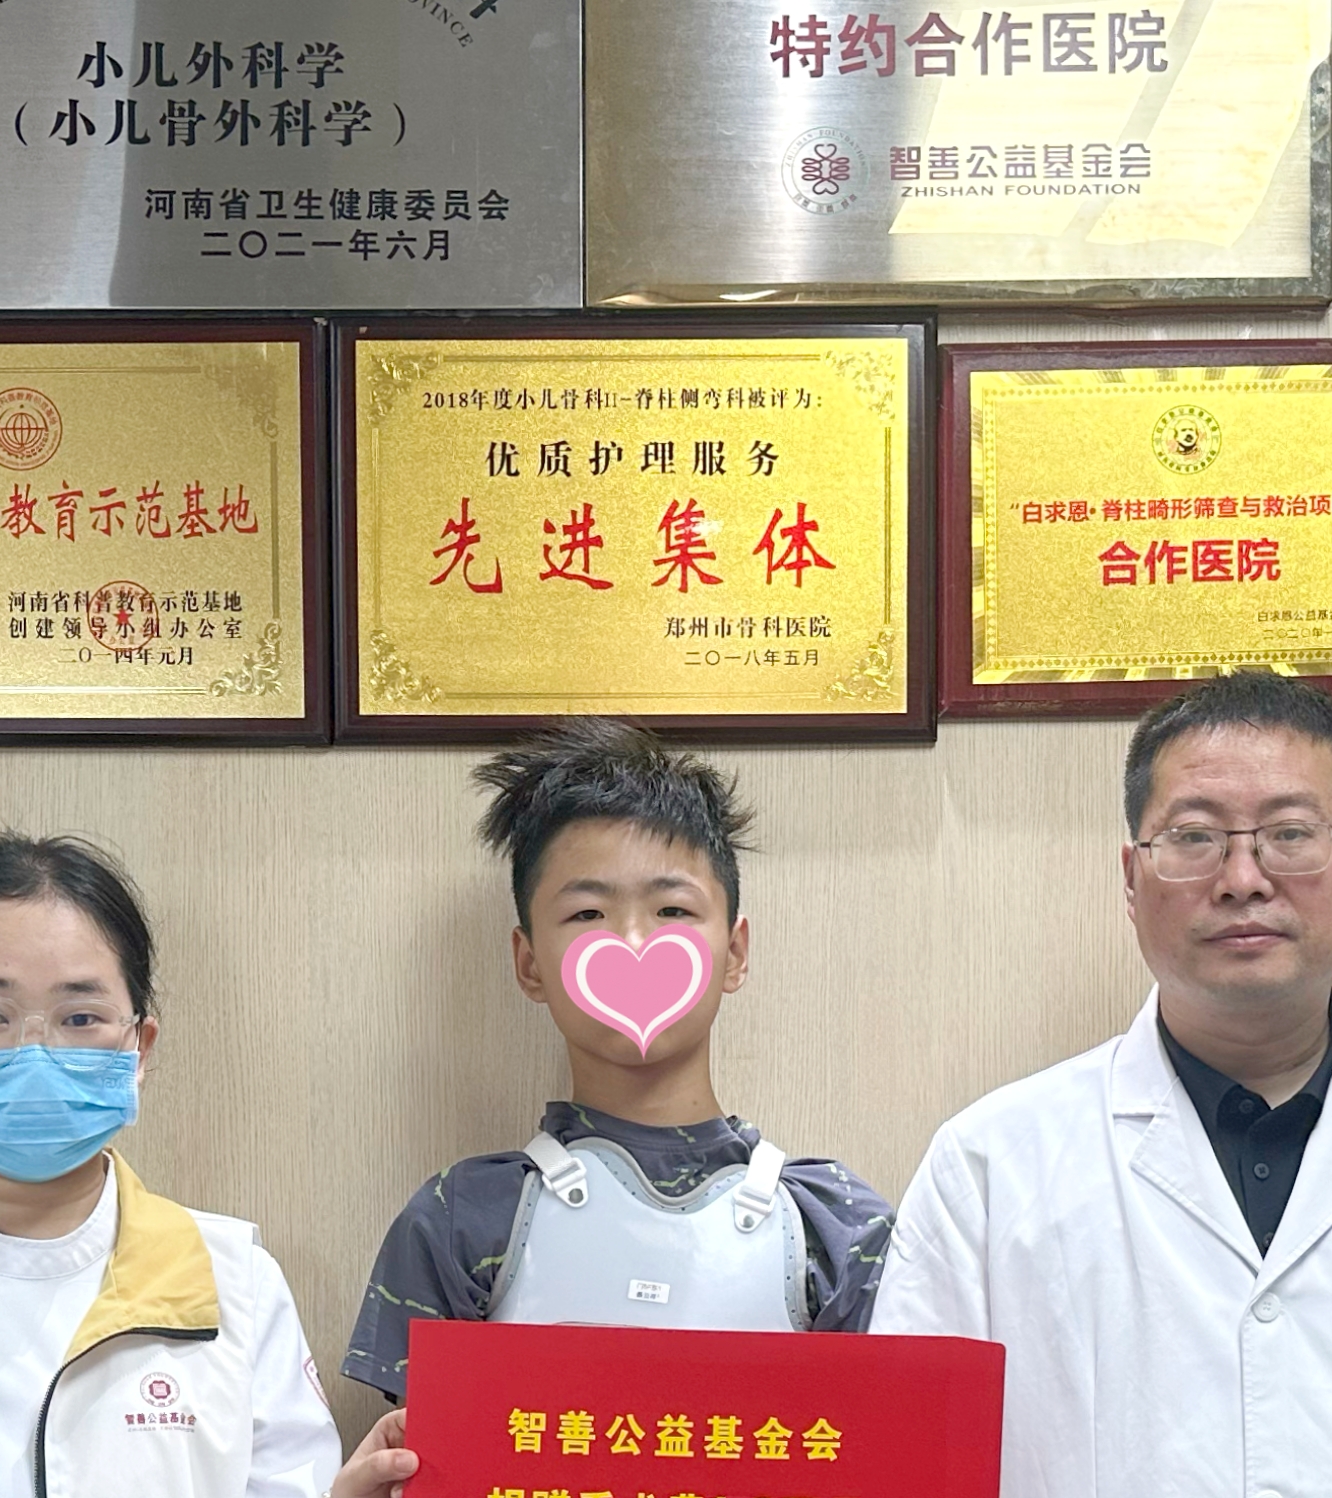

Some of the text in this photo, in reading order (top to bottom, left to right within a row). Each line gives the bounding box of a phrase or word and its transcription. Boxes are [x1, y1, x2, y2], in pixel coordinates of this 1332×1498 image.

[769, 11, 1169, 78] 特约合作医院
[76, 41, 345, 89] 小儿外科学
[889, 143, 1151, 181] 智善公益基金会
[145, 187, 510, 221] 河南省卫生健康委员会
[900, 183, 1141, 198] ZHISHAN FOUNDATION
[485, 440, 780, 478] 优质护理服务
[429, 496, 837, 594] 先进集体
[1097, 537, 1283, 587] 合作医院
[8, 590, 243, 613] 河南省科普教育示范基地
[9, 617, 243, 640] 创建领导小组办公室
[663, 616, 832, 639] 郑州市骨科医院
[507, 1407, 842, 1462] 智善公益基金会
